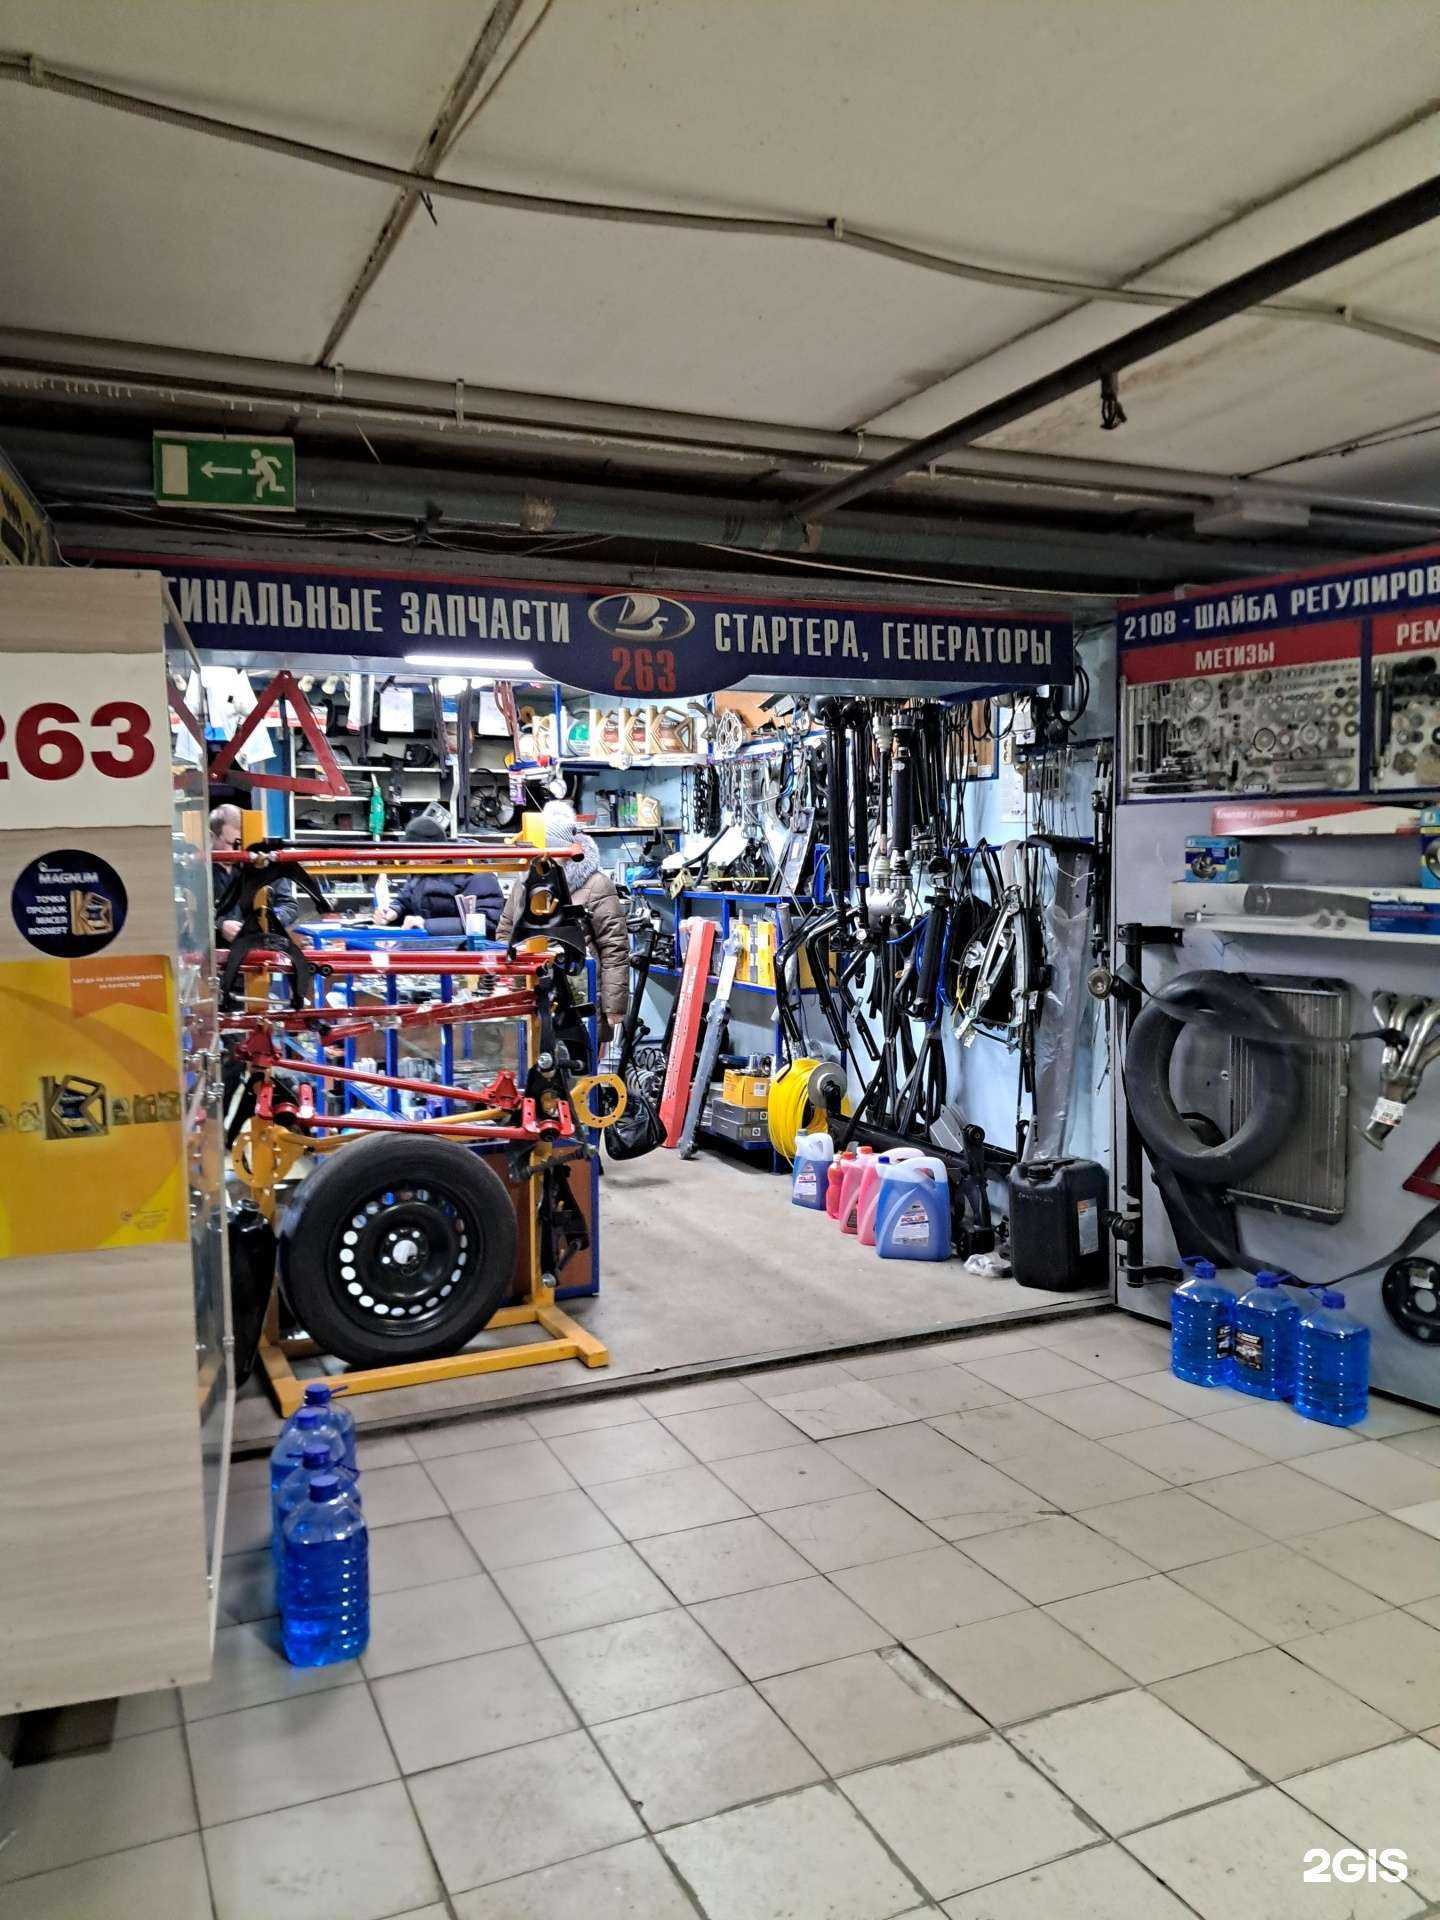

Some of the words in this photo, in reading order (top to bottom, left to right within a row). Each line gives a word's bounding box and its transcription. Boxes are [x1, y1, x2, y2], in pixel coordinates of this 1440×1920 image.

[400, 591, 570, 643] ЗАПЧАСТИ
[1124, 610, 1177, 640] 2108
[1195, 592, 1278, 630] ШАЙБА
[1290, 565, 1440, 615] РЕГУЛИРОВ
[714, 612, 869, 662] СТАРТЕРА,
[882, 621, 1052, 665] ГЕНЕРАТОРЫ
[1195, 641, 1275, 672] МЕТИЗЫ
[611, 646, 677, 692] 263
[0, 701, 155, 781] 63
[38, 872, 99, 884] MAGNUM
